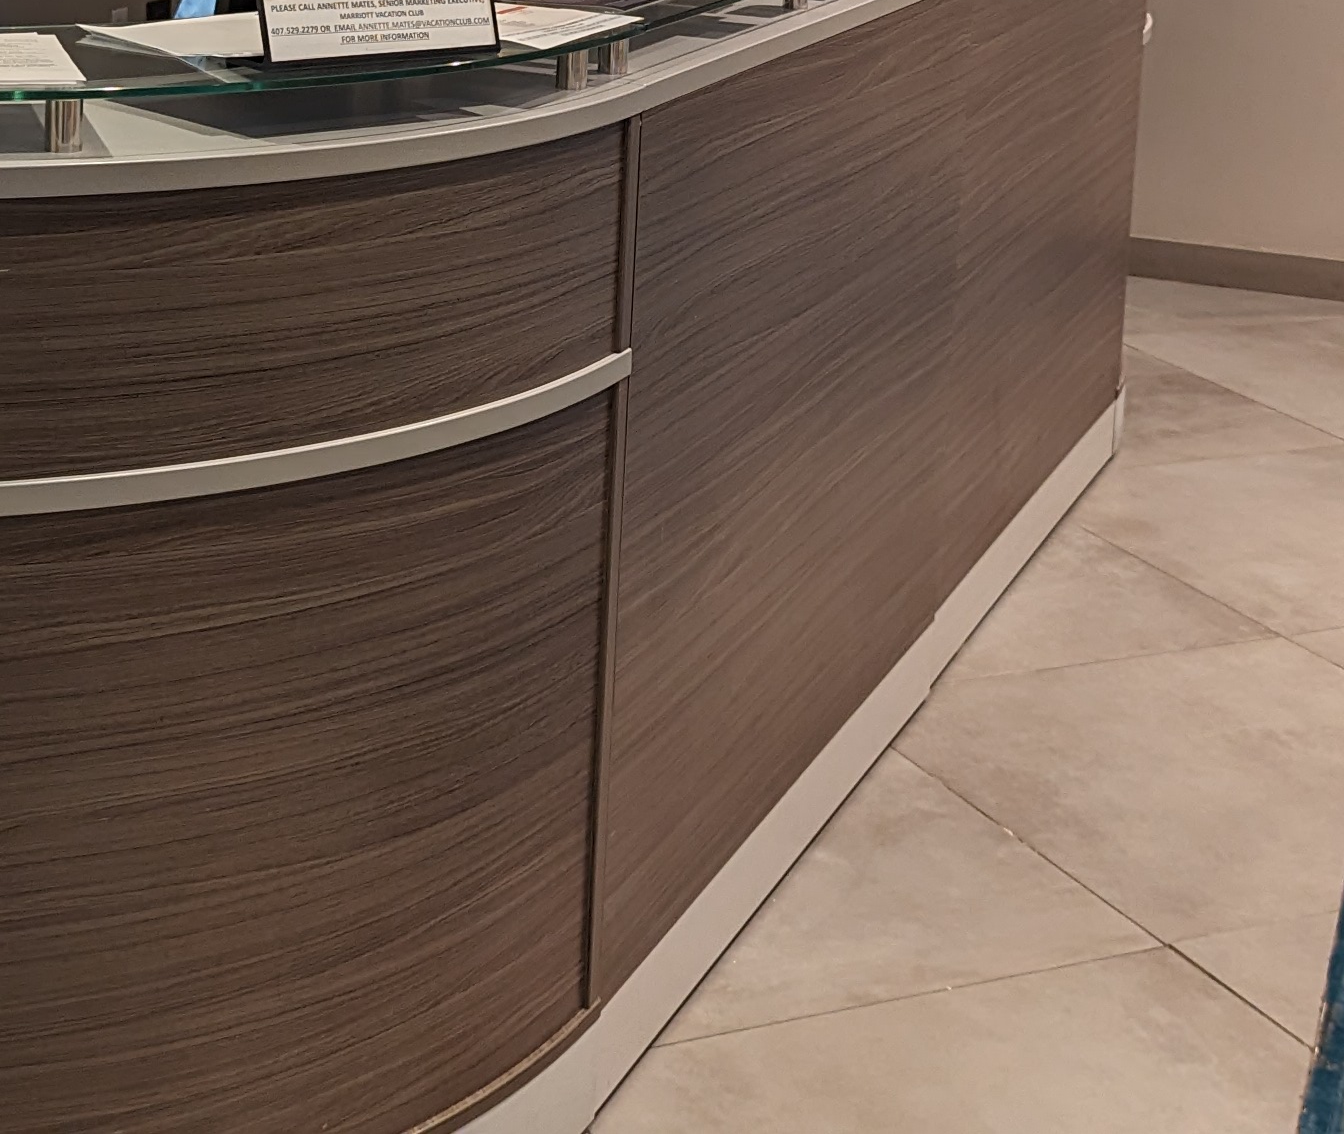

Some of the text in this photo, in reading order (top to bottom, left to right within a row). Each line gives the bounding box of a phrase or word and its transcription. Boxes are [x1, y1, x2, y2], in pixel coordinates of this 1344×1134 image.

[270, 4, 297, 13] PLEASE
[298, 2, 315, 11] CALL
[316, 1, 349, 10] ANNETTE
[351, 0, 377, 9] MATES,
[378, 0, 404, 8] SENIOR
[339, 9, 424, 20] MARRIOTT VACATION CLUB
[320, 24, 331, 33] OR
[334, 23, 356, 32] EMAIL
[341, 31, 430, 43] FOR MORE INFORMATION
